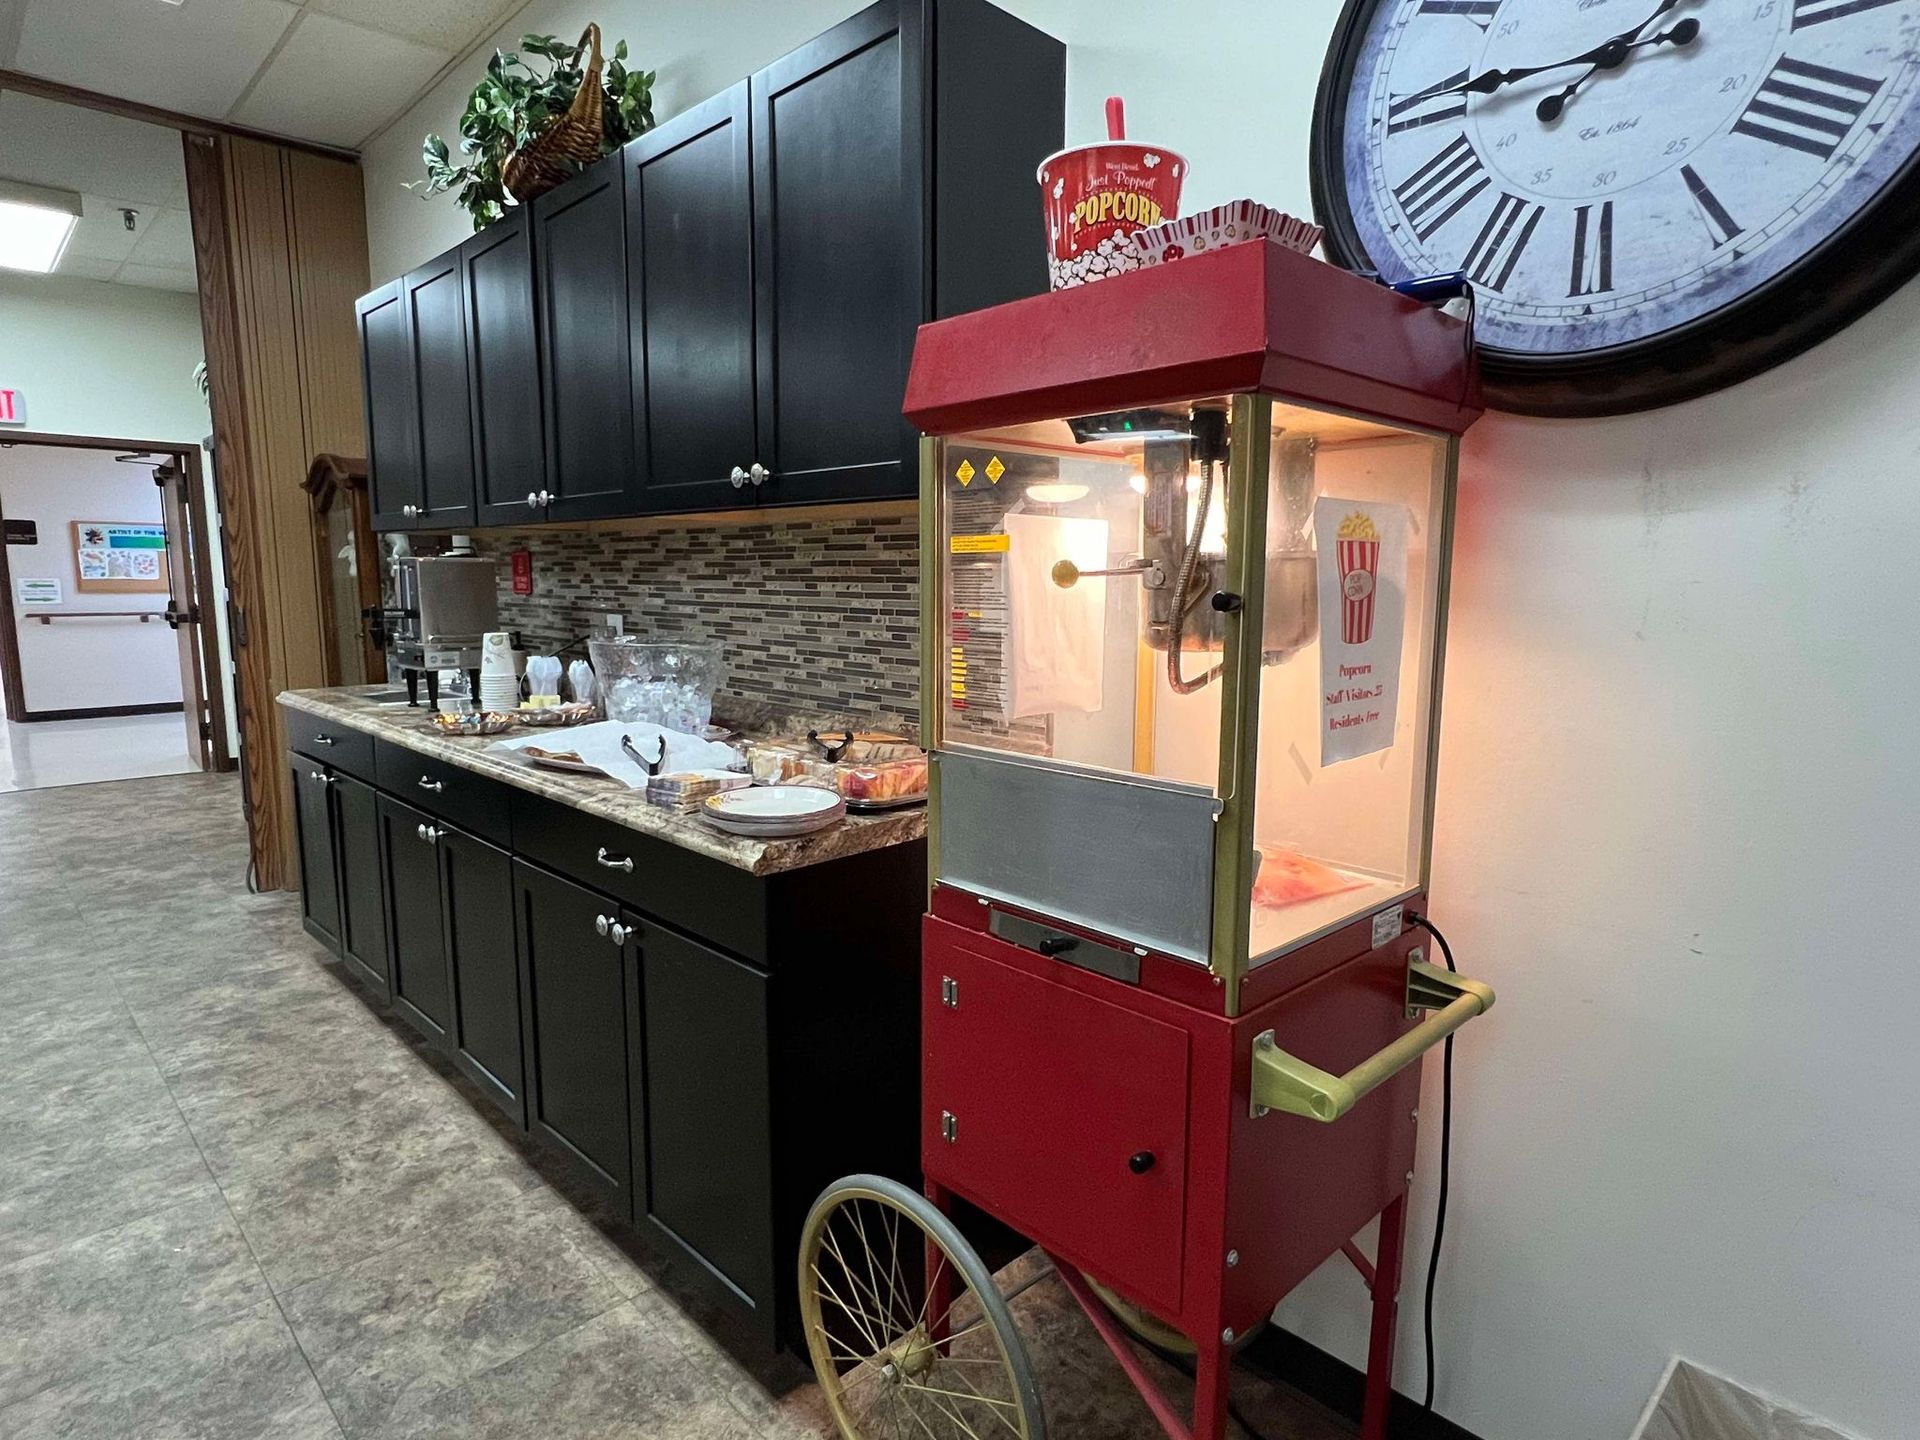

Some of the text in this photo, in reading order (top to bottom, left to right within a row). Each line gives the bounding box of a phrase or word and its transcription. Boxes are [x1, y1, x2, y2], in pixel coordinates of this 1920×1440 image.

[1753, 1, 1775, 21] 15
[1497, 19, 1520, 38] 50
[1718, 73, 1748, 93] 20
[1728, 51, 1888, 163] IIII
[1496, 133, 1518, 150] 40
[1662, 137, 1690, 155] 25
[1085, 174, 1108, 192] Just
[1530, 168, 1554, 185] 35
[1591, 170, 1617, 188] 30
[1073, 191, 1162, 234] POPCORN
[1339, 664, 1372, 680] Popcorn
[1329, 710, 1380, 730] Residents Free
